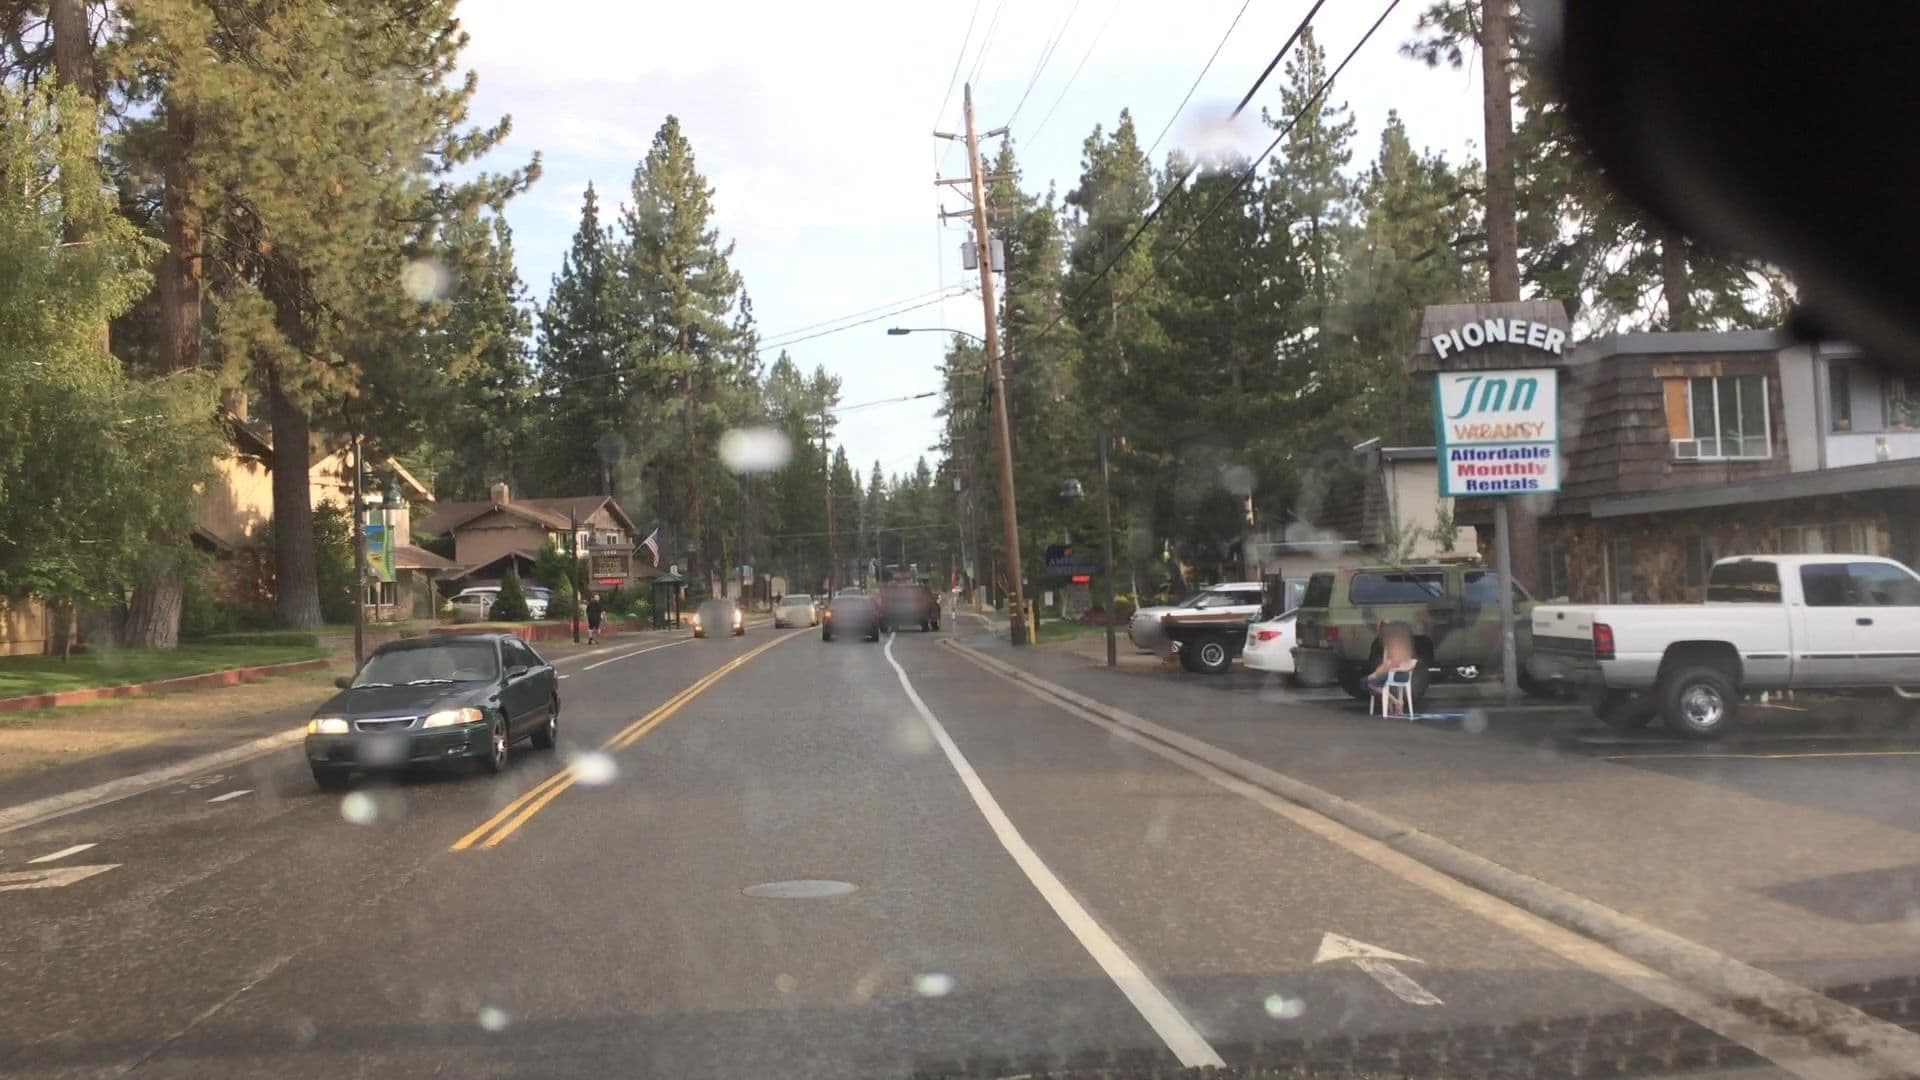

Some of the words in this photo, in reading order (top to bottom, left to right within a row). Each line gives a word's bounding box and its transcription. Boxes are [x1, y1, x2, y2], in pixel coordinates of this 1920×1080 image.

[1432, 318, 1566, 359] PIONEER
[1447, 376, 1538, 419] Inn
[1451, 447, 1551, 461] Affordable
[1457, 462, 1547, 477] Monthly
[1466, 478, 1538, 491] Rentals
